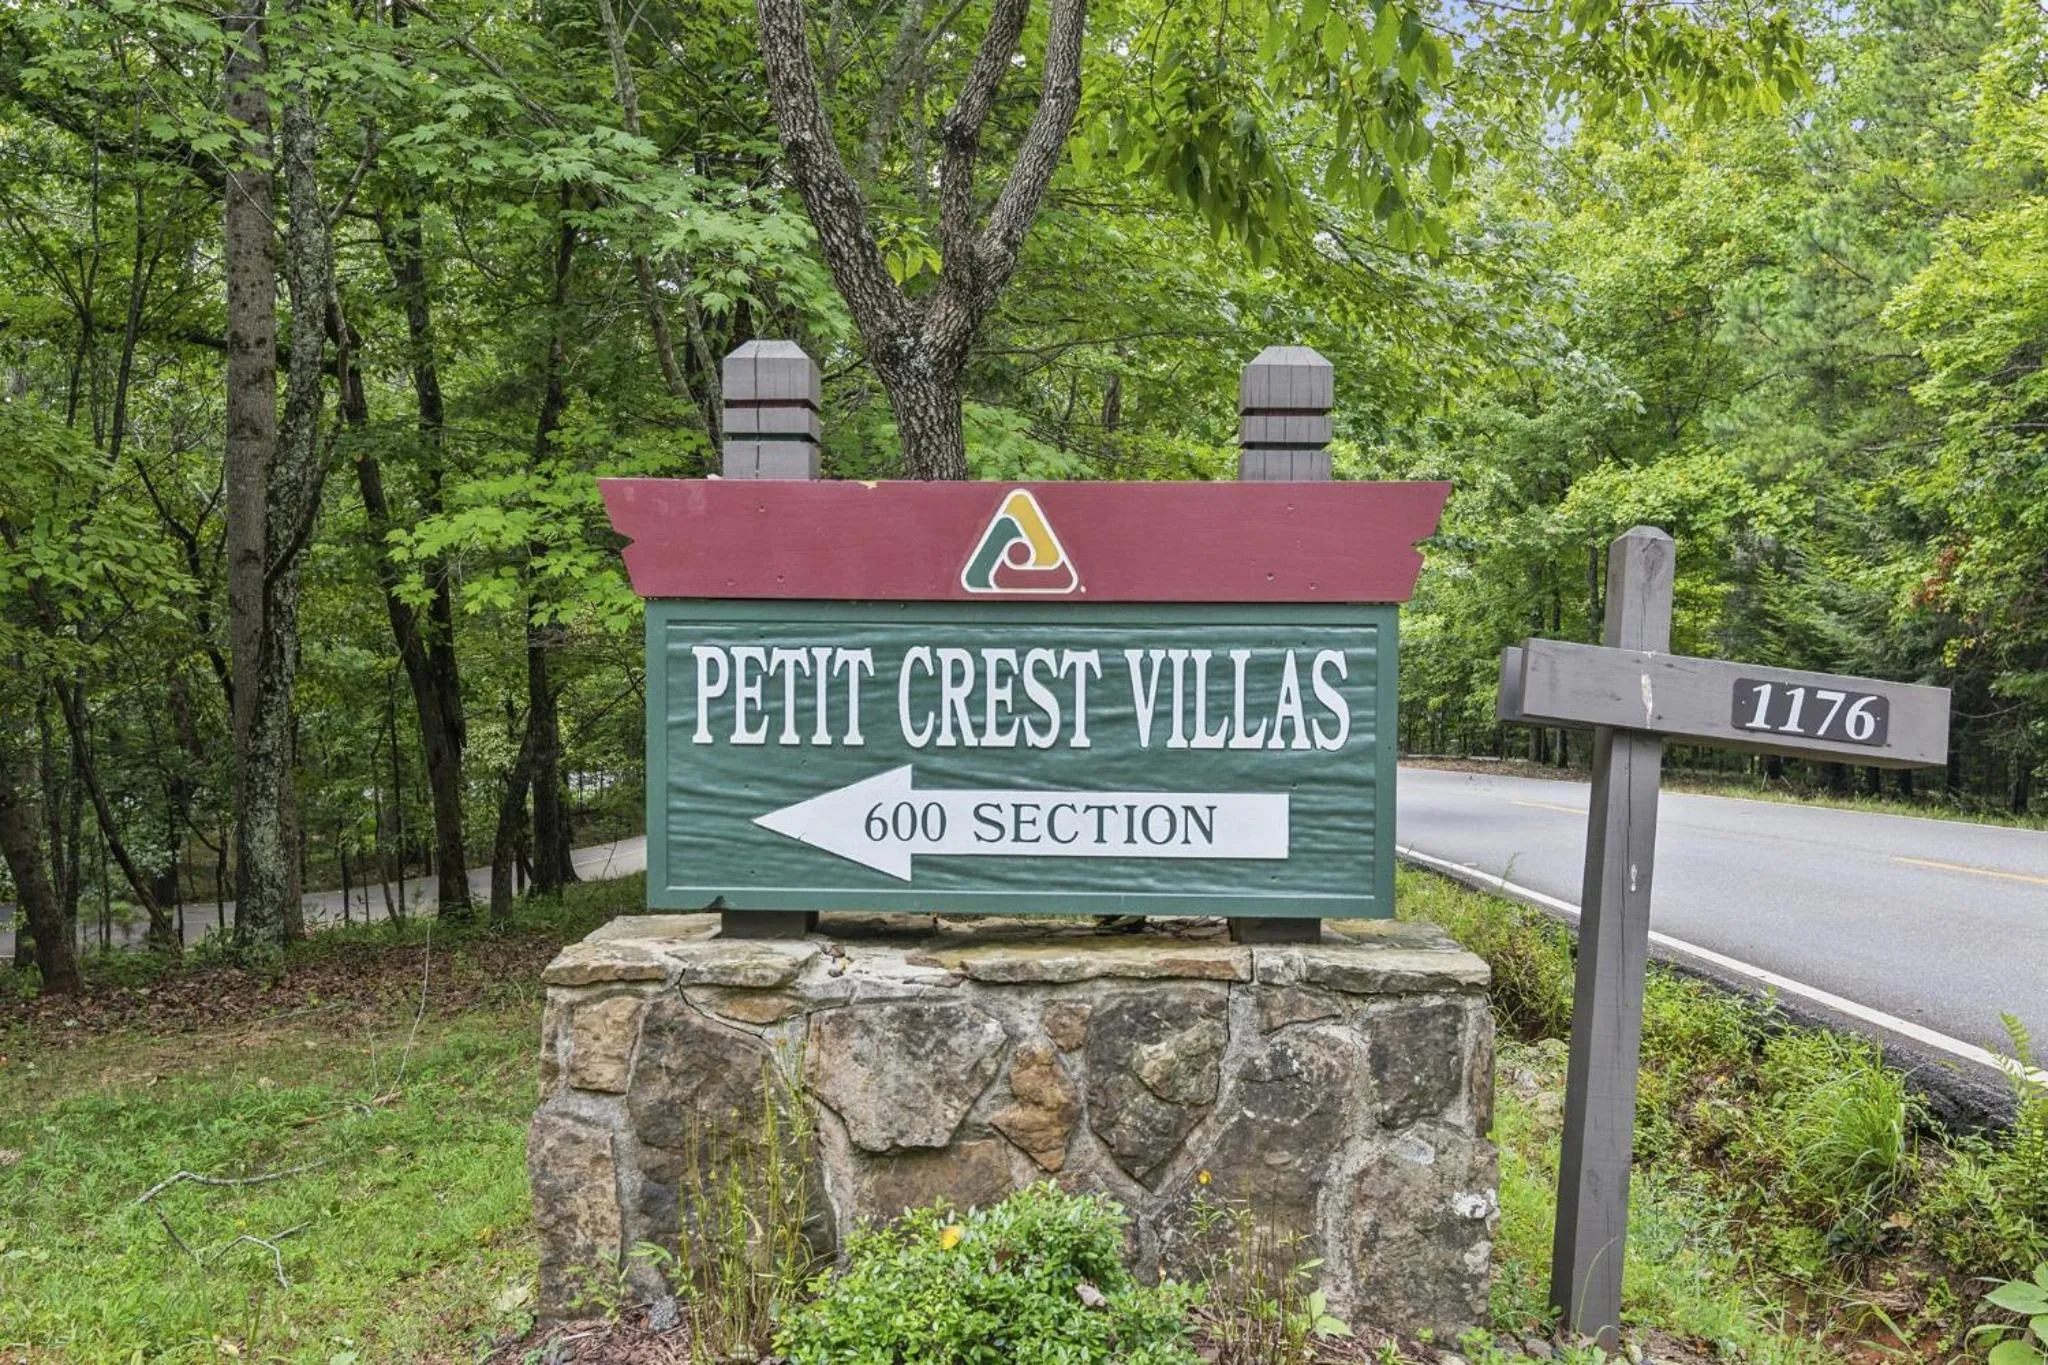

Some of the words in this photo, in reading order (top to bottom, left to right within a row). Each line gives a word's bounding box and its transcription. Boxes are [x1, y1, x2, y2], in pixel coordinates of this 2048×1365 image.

[691, 645, 875, 745] PETIT
[898, 645, 1102, 748] CREST
[1123, 647, 1351, 751] VILLAS
[1745, 683, 1878, 741] 1176
[864, 801, 948, 843] 600
[973, 802, 1218, 846] SECTION
